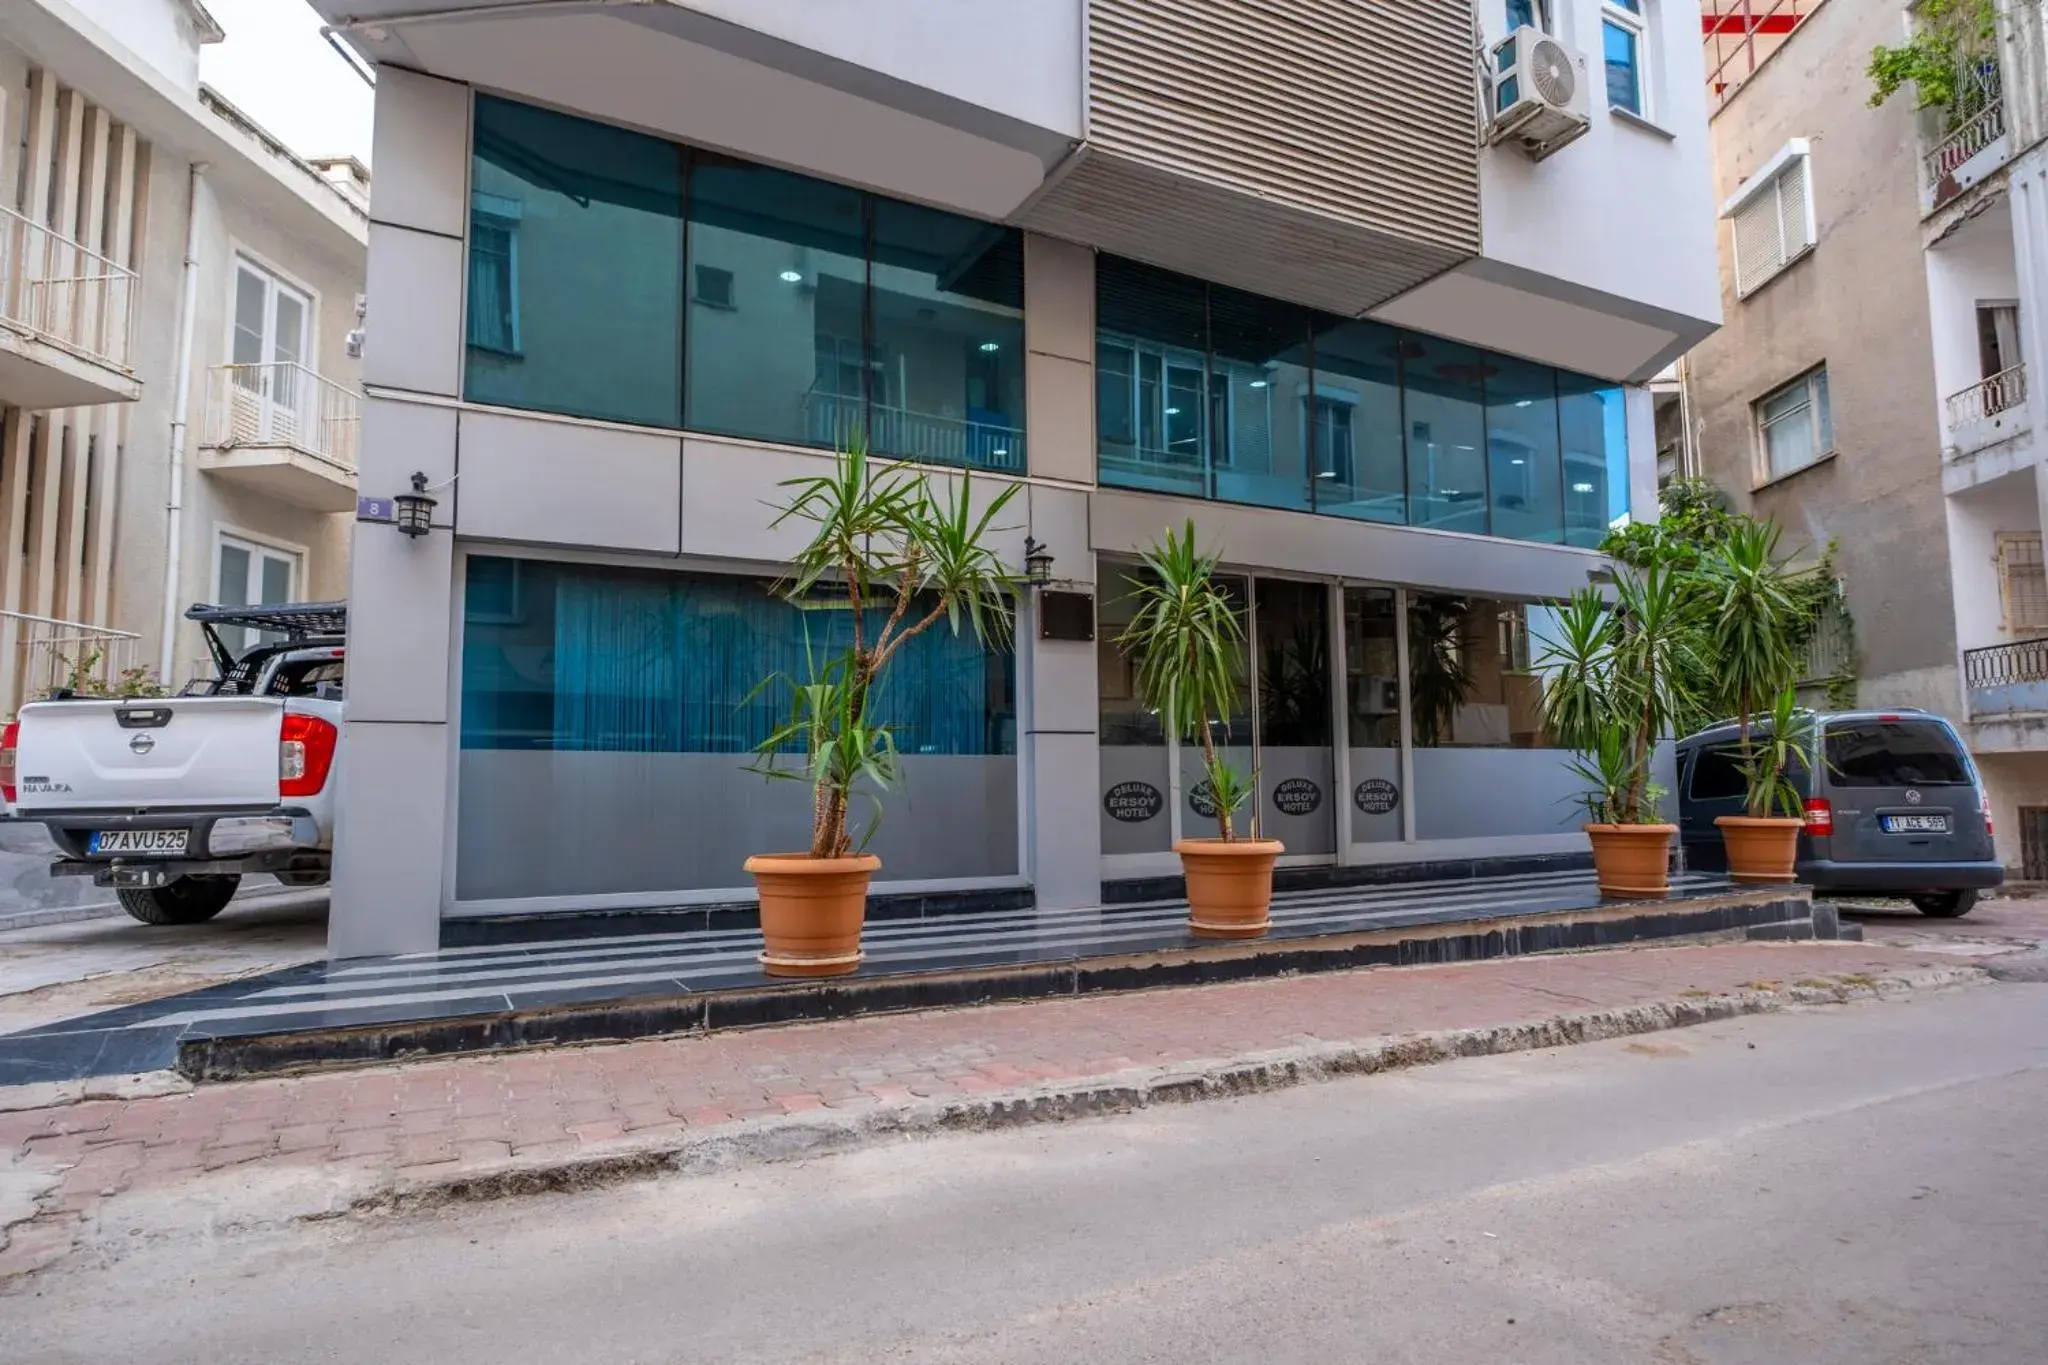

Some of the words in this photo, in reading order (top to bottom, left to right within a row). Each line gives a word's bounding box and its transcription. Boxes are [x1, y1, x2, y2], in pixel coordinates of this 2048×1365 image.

[1114, 783, 1153, 797] DELUXE
[1281, 780, 1314, 791] DELUXE
[1277, 792, 1317, 802] ERSOY
[1358, 792, 1394, 801] ERSOY
[1109, 798, 1156, 808] ERSOY
[1283, 802, 1312, 811] HOTEL
[1363, 801, 1389, 810] HOTEL
[1116, 807, 1151, 818] HOTEL
